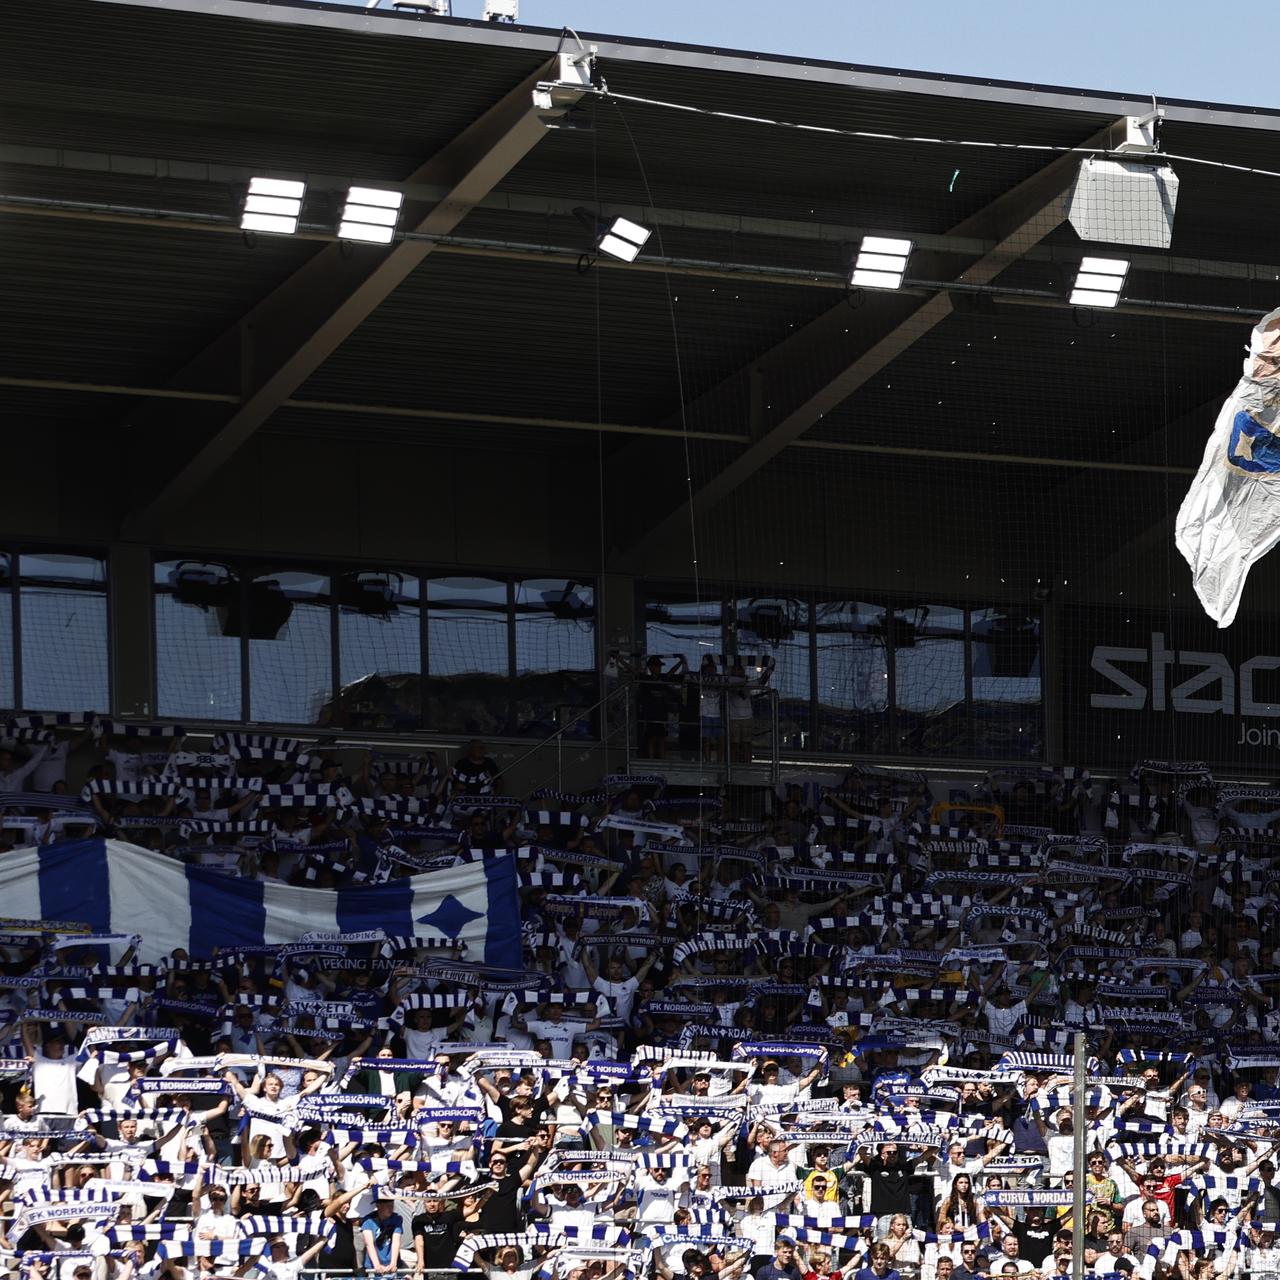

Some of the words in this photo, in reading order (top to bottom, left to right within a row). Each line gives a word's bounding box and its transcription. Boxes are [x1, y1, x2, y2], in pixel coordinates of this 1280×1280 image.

[1237, 721, 1280, 747] Join
[323, 957, 369, 971] PEKING
[663, 1002, 715, 1014] NORRKÖPING
[759, 1046, 821, 1058] NORRKÖPING
[143, 1081, 158, 1092] IFK
[159, 1079, 222, 1093] NORRKÖPING
[905, 1086, 959, 1099] NORKÖPING
[309, 1096, 325, 1107] IFK
[326, 1095, 387, 1108] NORRKÖPING
[1249, 1119, 1280, 1130] CURVA
[559, 1171, 627, 1185] NORRKÖPING
[999, 1192, 1031, 1204] CURVA
[1033, 1192, 1075, 1204] NORDAH
[30, 1210, 45, 1221] IFK
[46, 1204, 118, 1219] NORRKÖPING
[663, 1233, 693, 1246] CURVA
